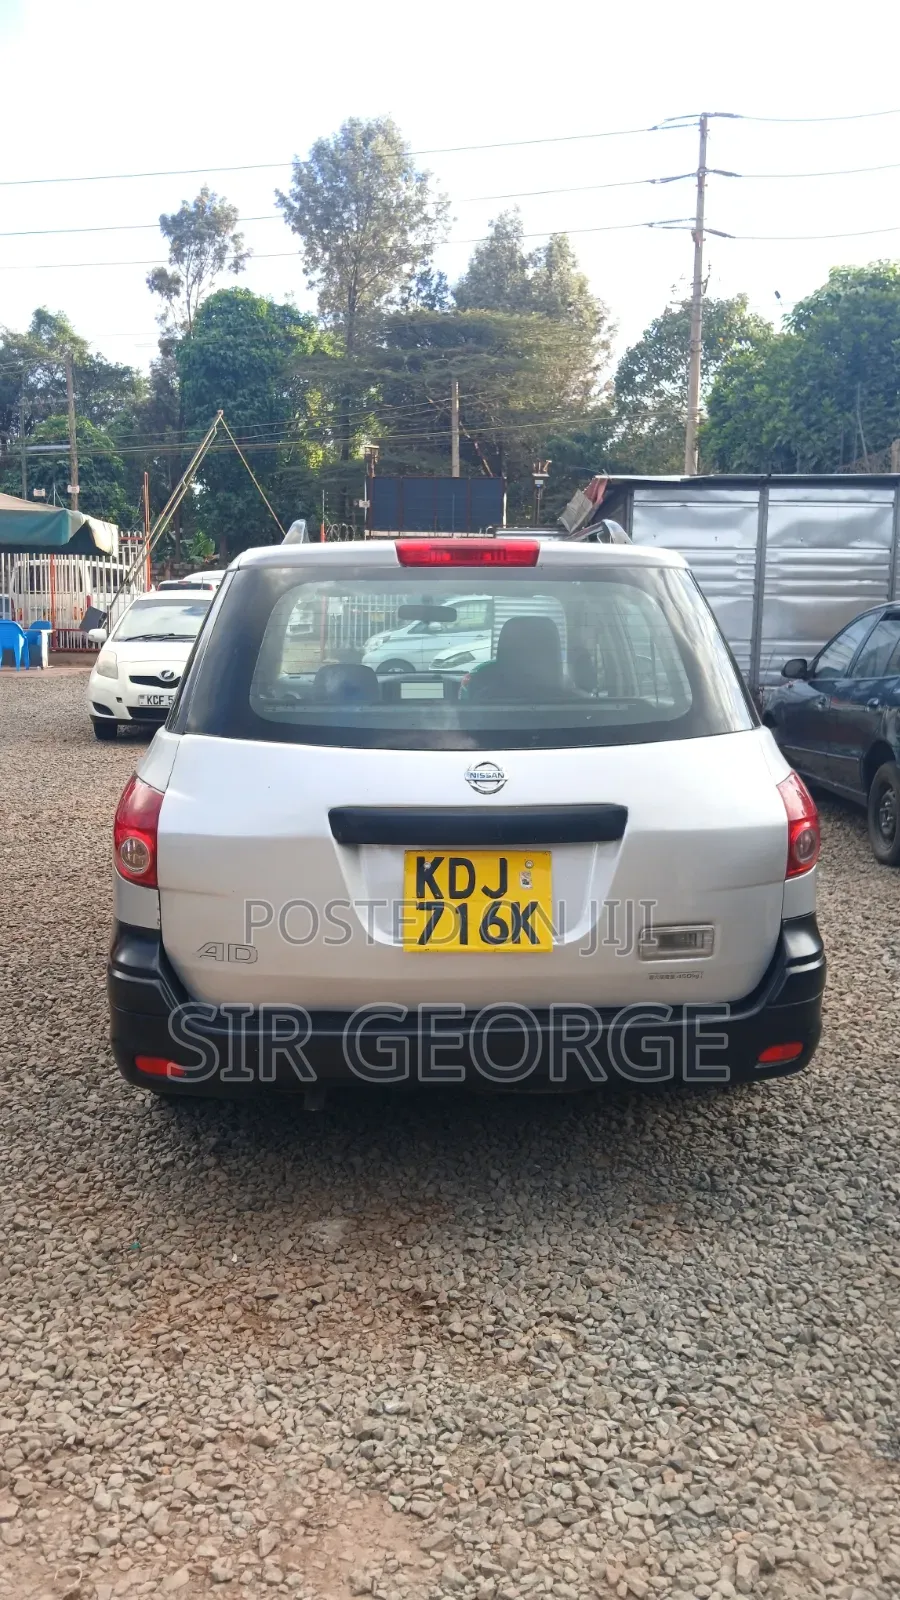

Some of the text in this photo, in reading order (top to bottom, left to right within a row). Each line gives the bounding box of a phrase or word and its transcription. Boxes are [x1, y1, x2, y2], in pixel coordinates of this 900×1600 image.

[147, 695, 164, 705] KCF
[416, 856, 508, 899] KDJ
[416, 901, 541, 946] 716K
[196, 941, 258, 964] AD
